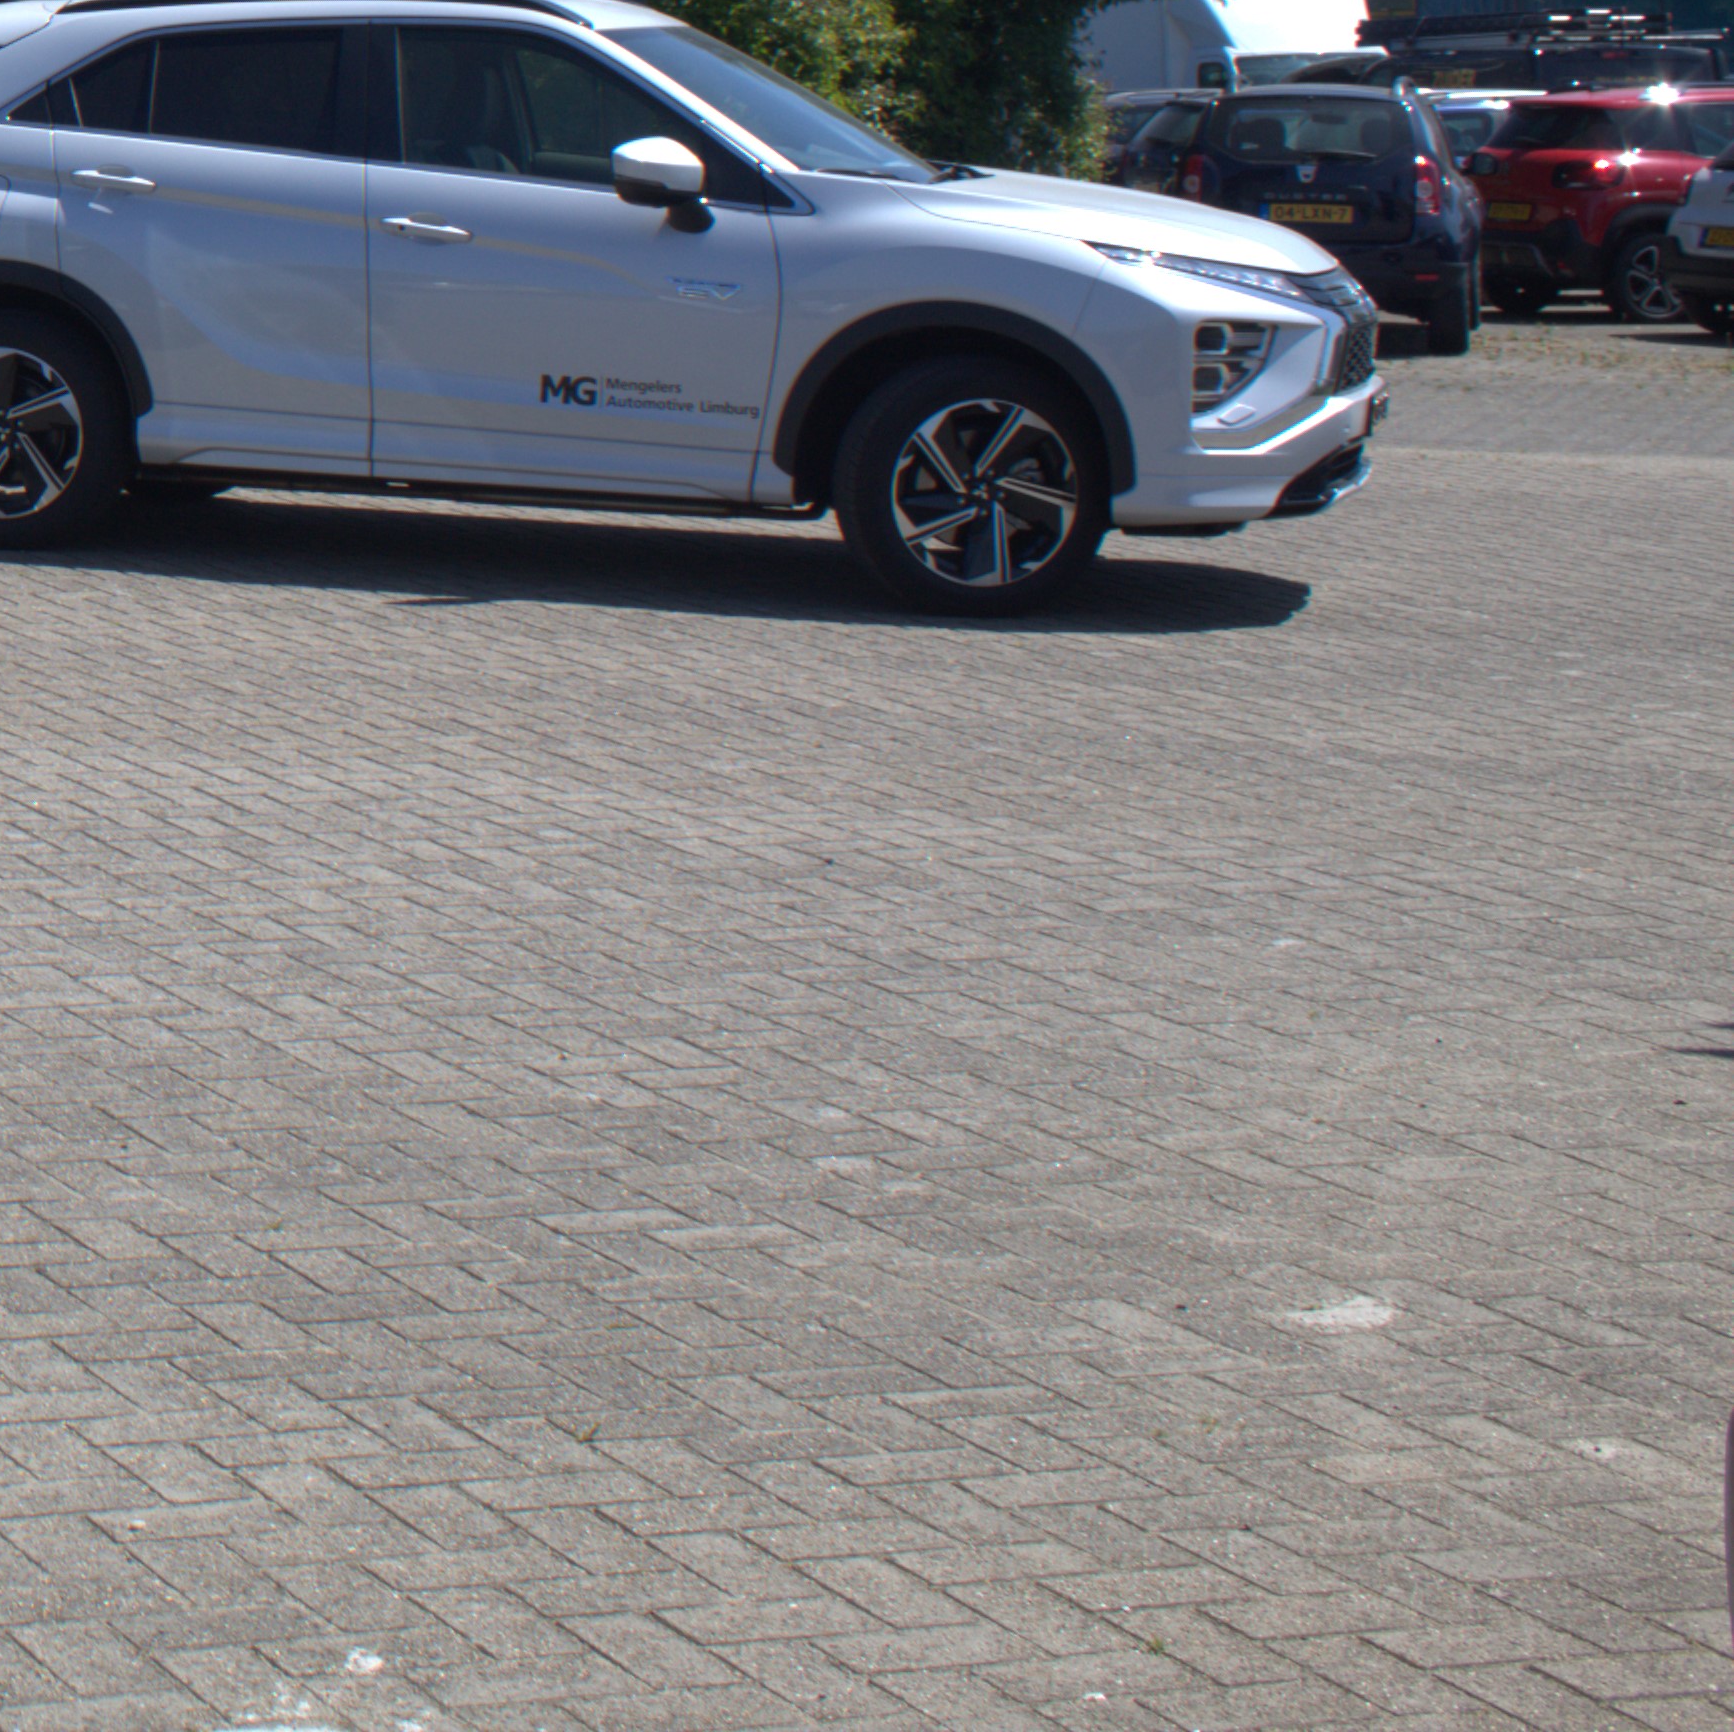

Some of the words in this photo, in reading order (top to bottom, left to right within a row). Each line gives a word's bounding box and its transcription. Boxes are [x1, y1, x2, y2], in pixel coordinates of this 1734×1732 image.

[539, 373, 598, 406] MG
[605, 377, 682, 395] Mengelers
[605, 395, 695, 412] Automotive
[699, 400, 760, 419] Limburg
